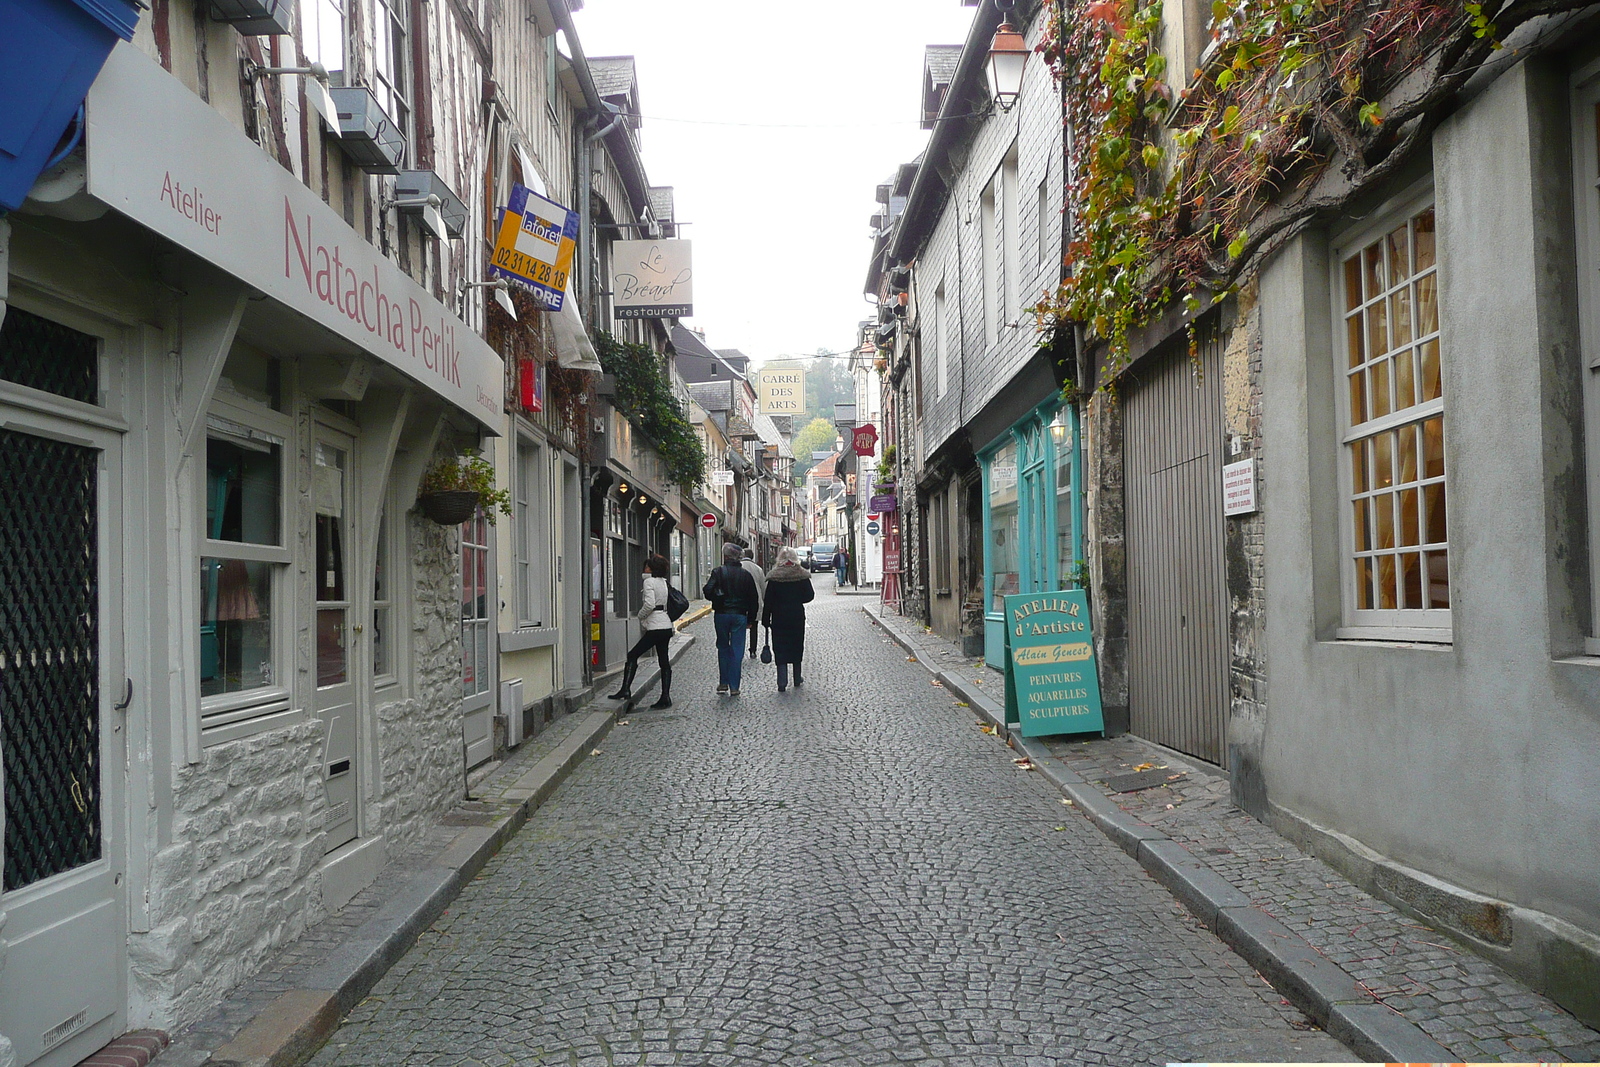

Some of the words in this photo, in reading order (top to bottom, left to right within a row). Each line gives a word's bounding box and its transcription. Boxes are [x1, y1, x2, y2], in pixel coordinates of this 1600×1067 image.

[160, 170, 222, 236] Atelier
[497, 246, 511, 267] 02
[510, 253, 524, 273] 31
[525, 259, 537, 278] 14
[538, 264, 552, 284] 28
[554, 269, 566, 289] 18
[639, 245, 667, 274] Le
[283, 195, 405, 353] Natacha
[409, 297, 463, 389] Perlik
[614, 268, 692, 302] Bréard
[619, 306, 688, 317] restaurant
[762, 373, 801, 383] CARRÉ
[771, 387, 793, 396] DES
[767, 400, 797, 409] ARTS
[1014, 598, 1080, 622] ATELIER
[1015, 620, 1085, 637] d'Artiste
[1016, 648, 1047, 662] Alain
[1052, 646, 1088, 662] Genest
[1030, 672, 1082, 686] PEINTURES
[1028, 688, 1087, 704] AQUARELLES
[1030, 705, 1090, 718] SCULPTURES
